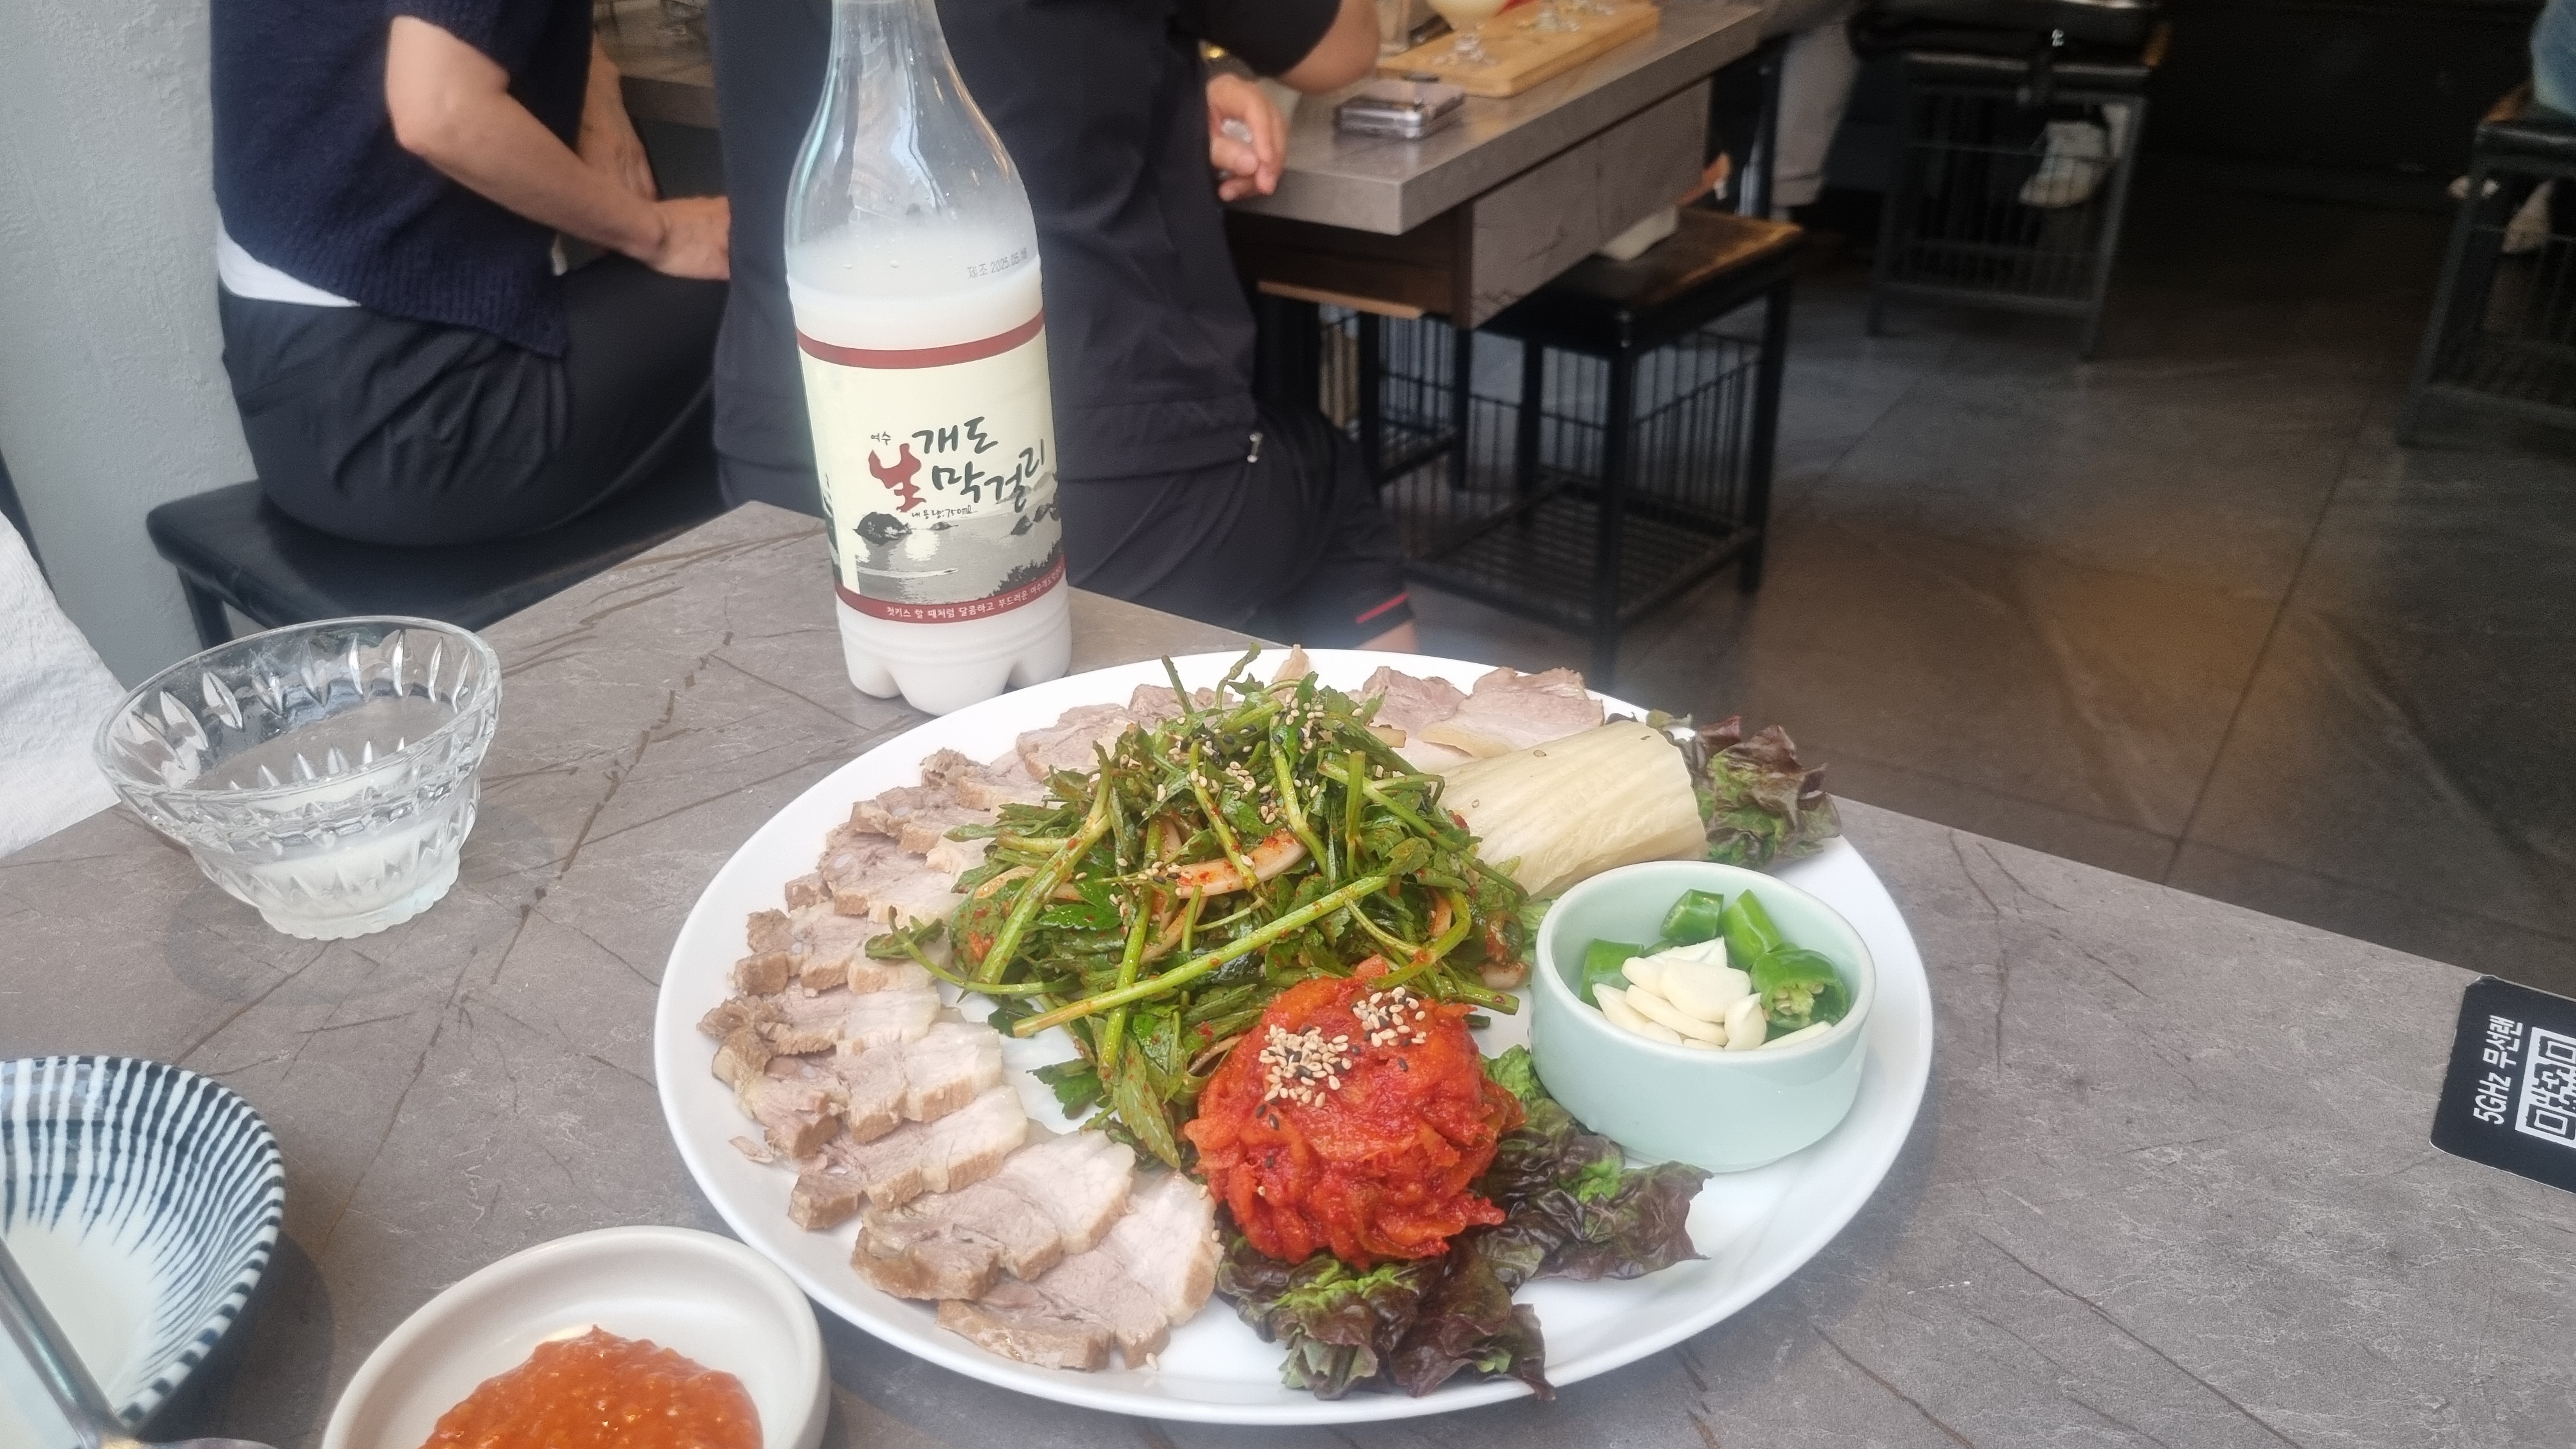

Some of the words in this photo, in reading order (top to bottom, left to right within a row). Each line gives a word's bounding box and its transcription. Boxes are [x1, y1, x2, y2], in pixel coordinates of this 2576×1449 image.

[870, 431, 892, 446] 여수
[911, 416, 999, 455] 개도
[868, 443, 927, 513] 생
[931, 438, 1045, 512] 막걸리
[887, 605, 912, 618] 첫키스
[915, 608, 924, 619] 할
[928, 608, 955, 618] 때처럼
[959, 601, 995, 617] 달콤하고
[999, 590, 1029, 608] 부드러운
[2482, 1014, 2524, 1069] 무선랜
[2472, 1071, 2511, 1125] 5GHz
